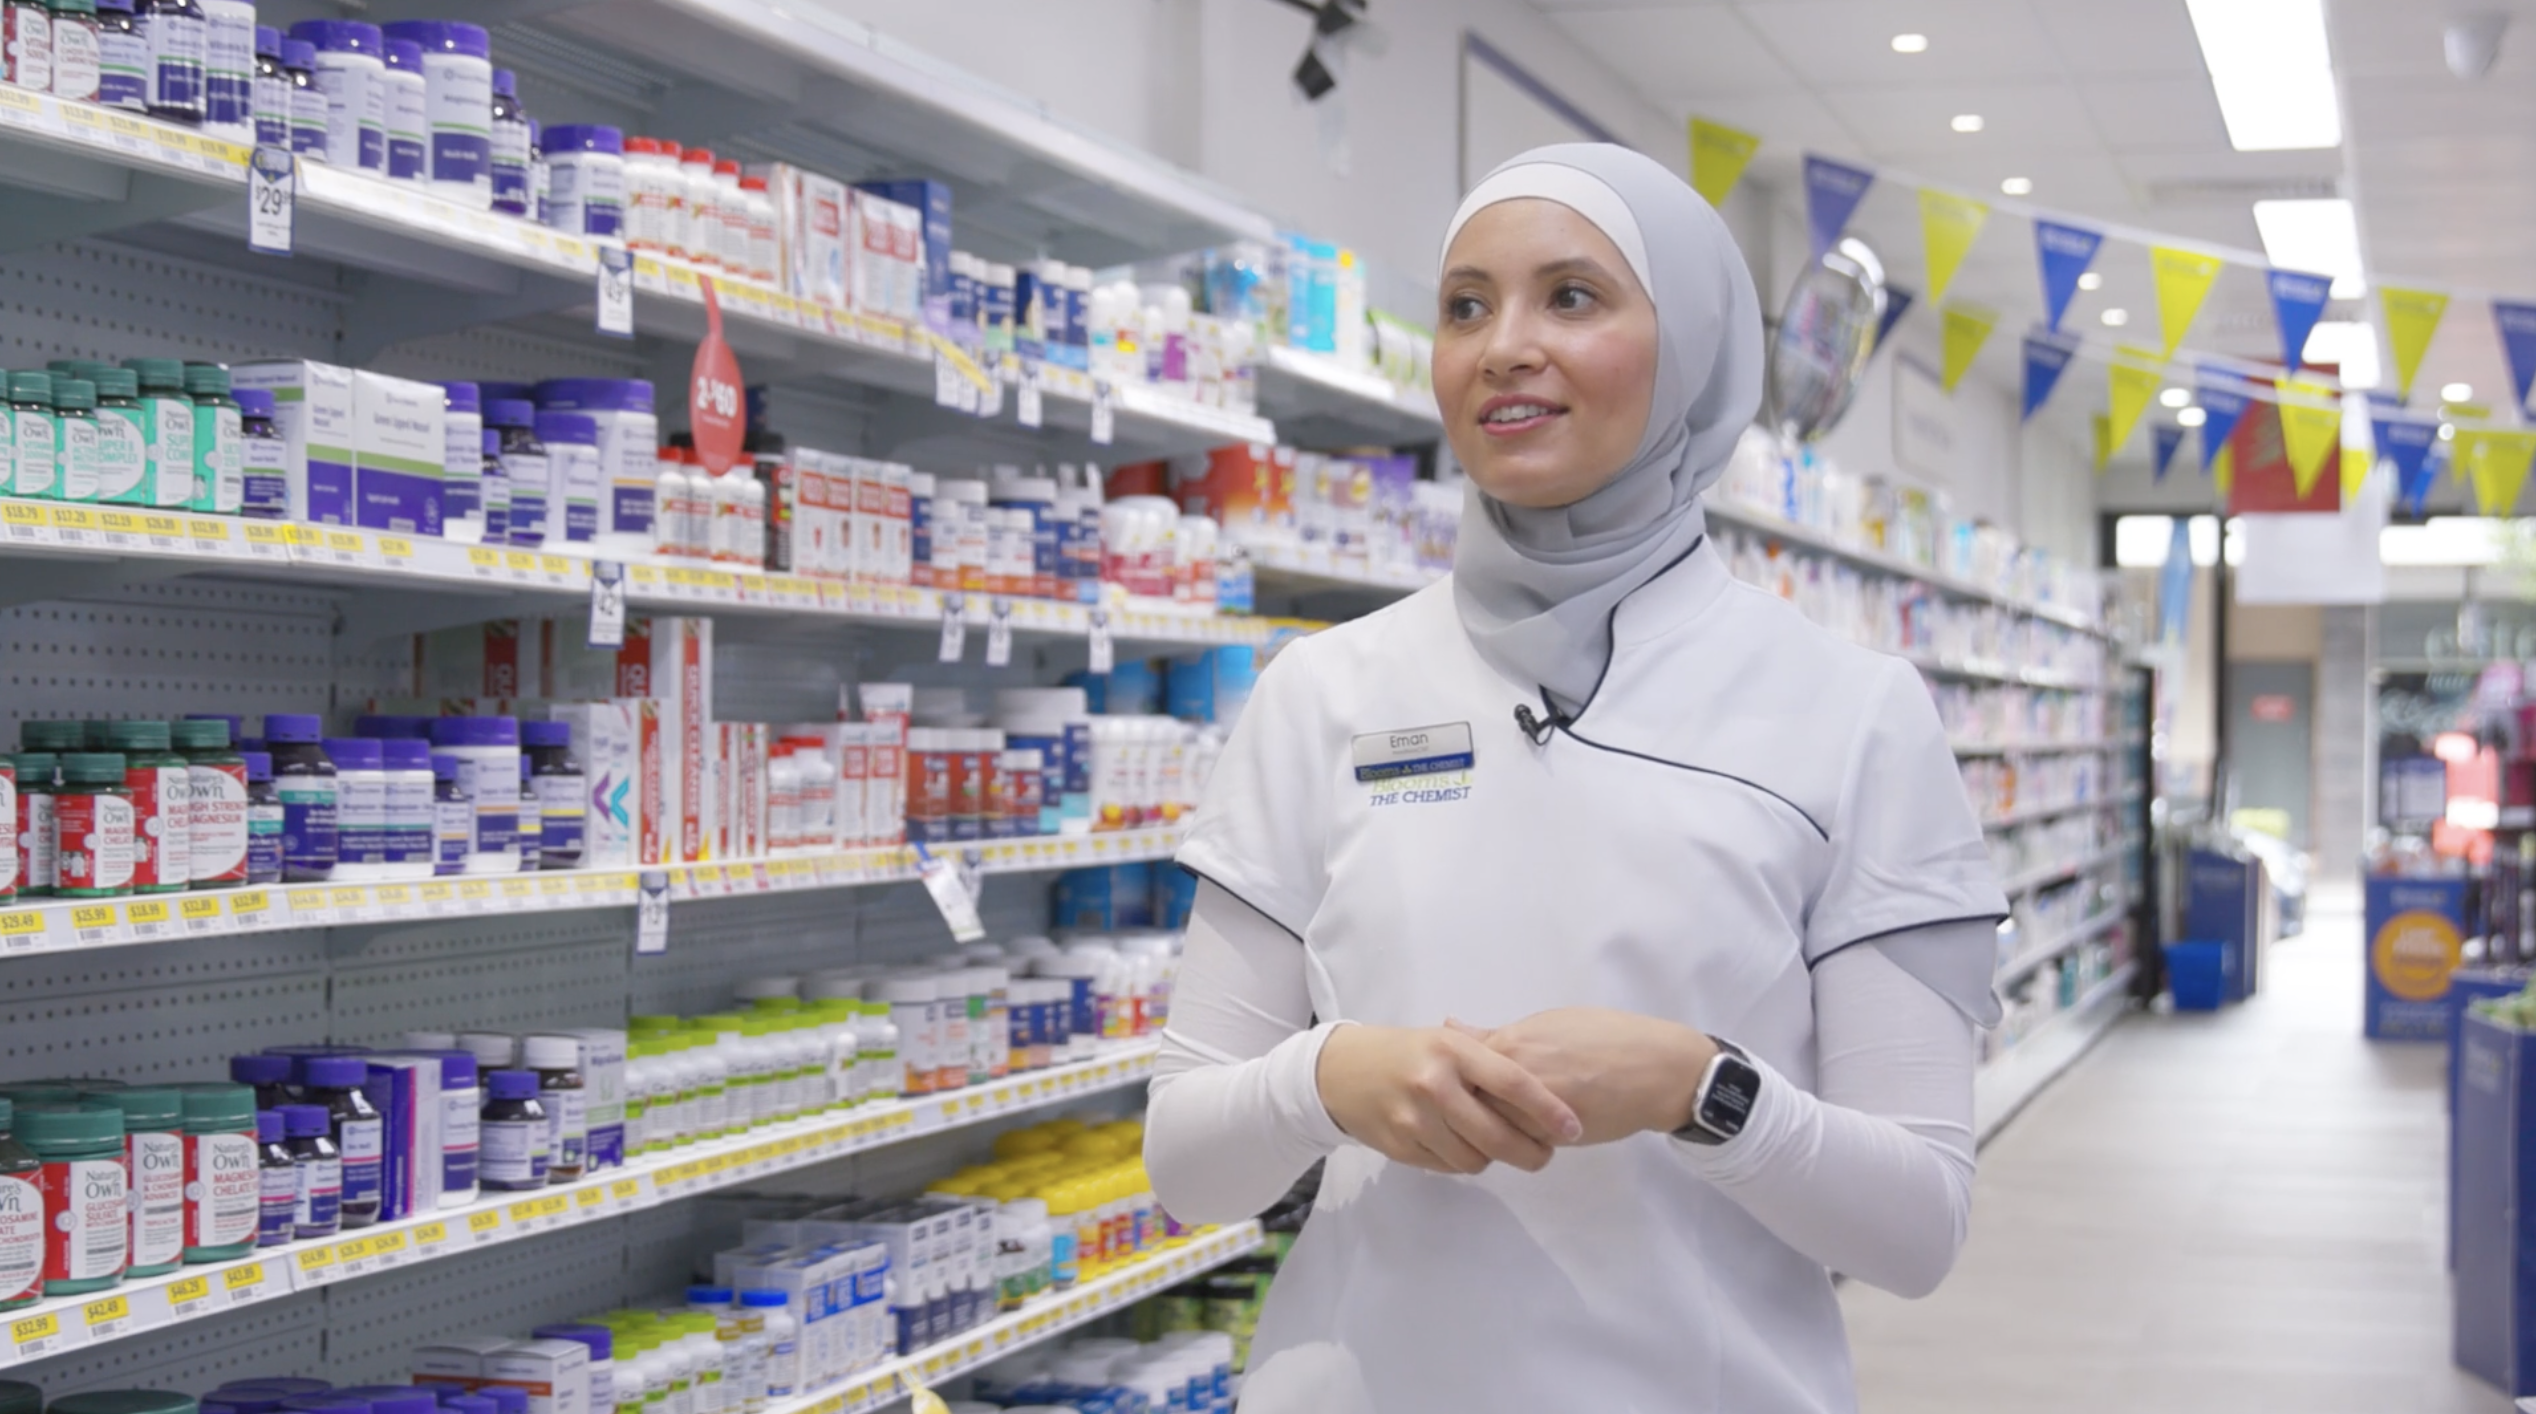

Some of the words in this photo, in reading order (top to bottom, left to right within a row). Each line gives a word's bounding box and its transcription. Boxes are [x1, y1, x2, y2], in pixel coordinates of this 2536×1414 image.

[1390, 733, 1429, 748] Eman
[1371, 792, 1399, 807] THE
[1402, 786, 1471, 804] CHEMIST
